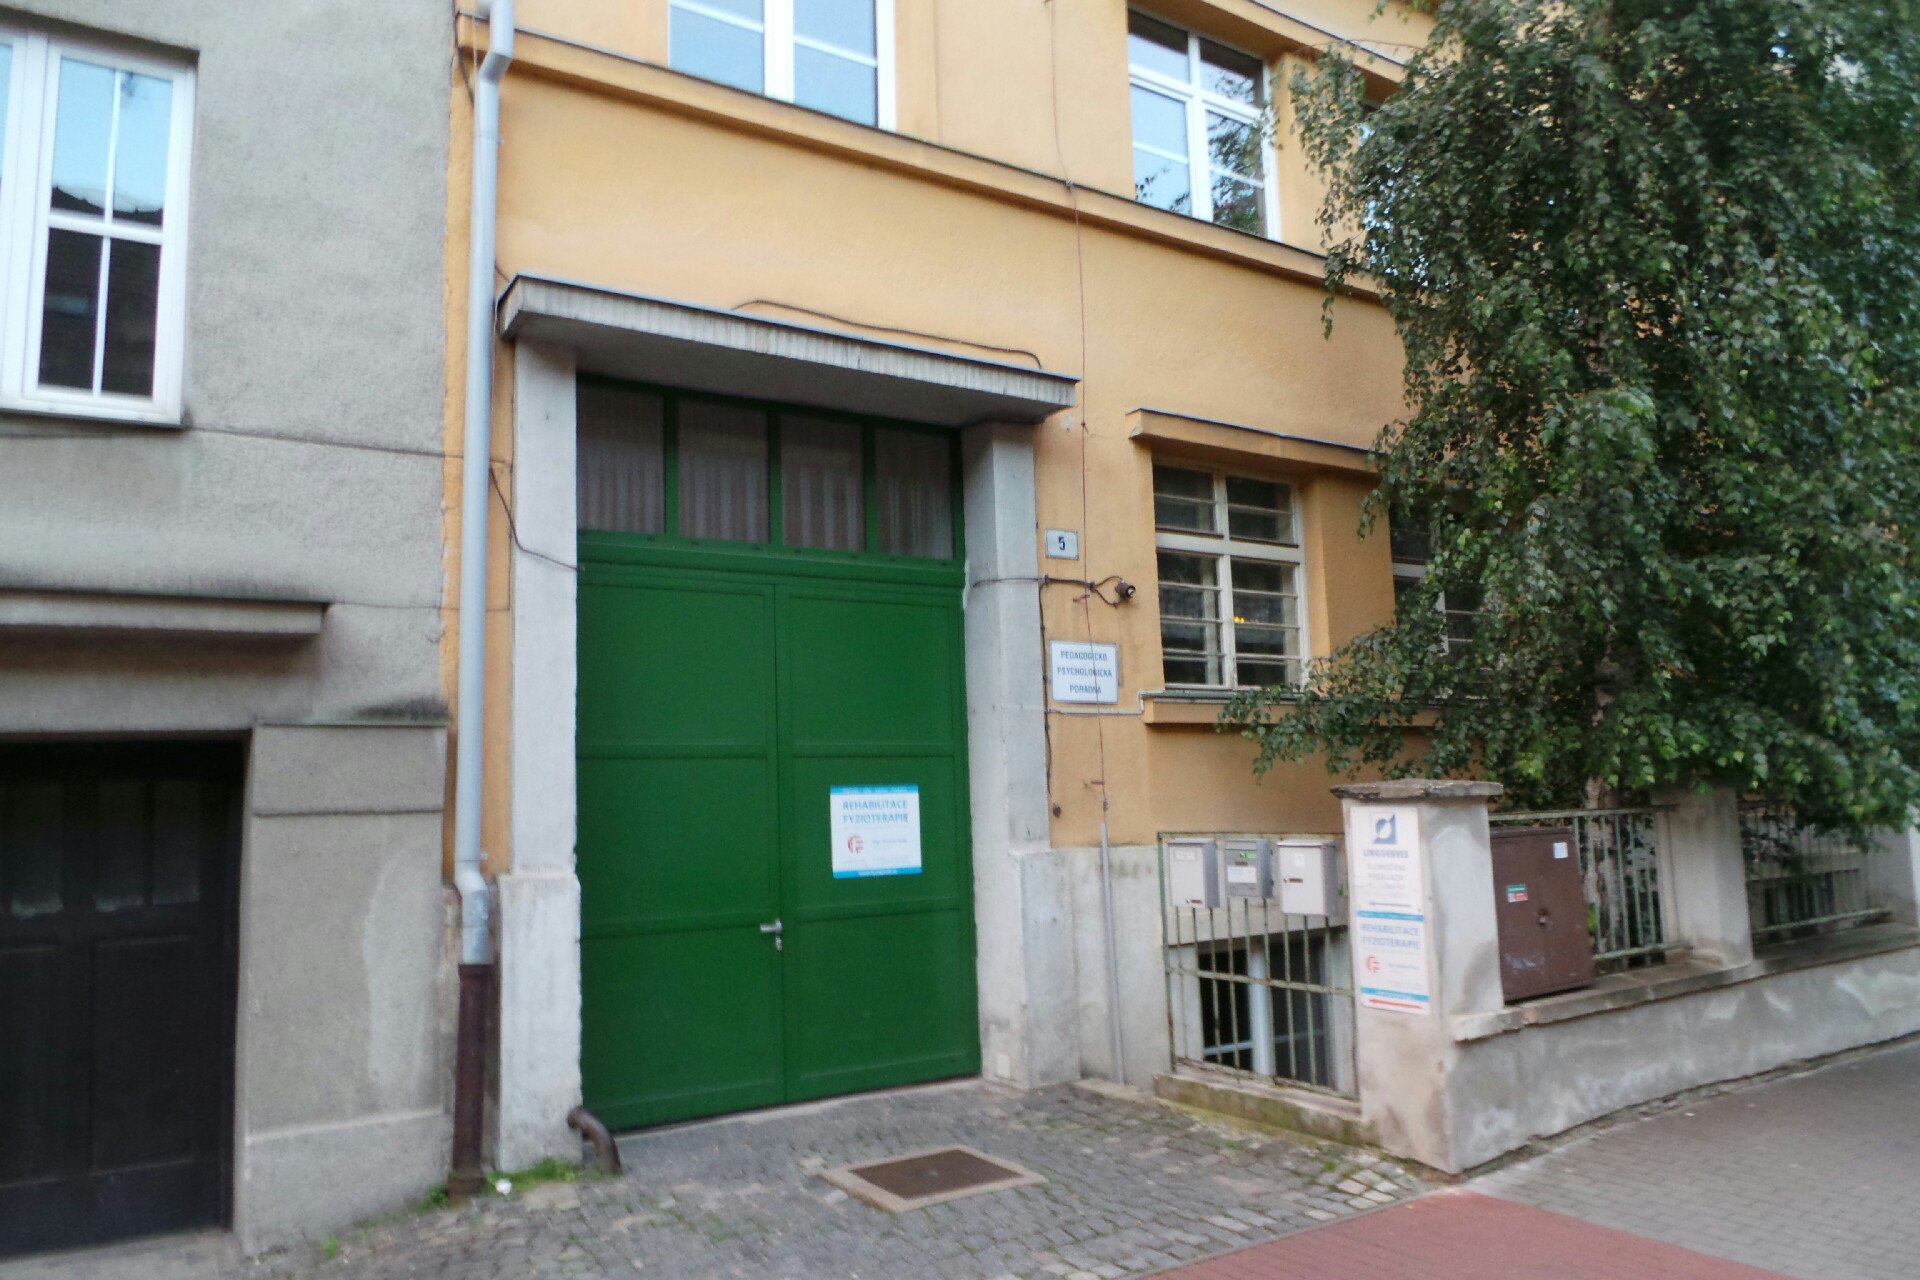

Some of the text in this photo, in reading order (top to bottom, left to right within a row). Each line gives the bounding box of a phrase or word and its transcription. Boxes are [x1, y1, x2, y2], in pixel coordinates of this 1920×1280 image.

[1058, 536, 1066, 551] 5
[842, 799, 908, 810] REHABILITACE
[842, 813, 909, 824] FYZIOTERAPIE
